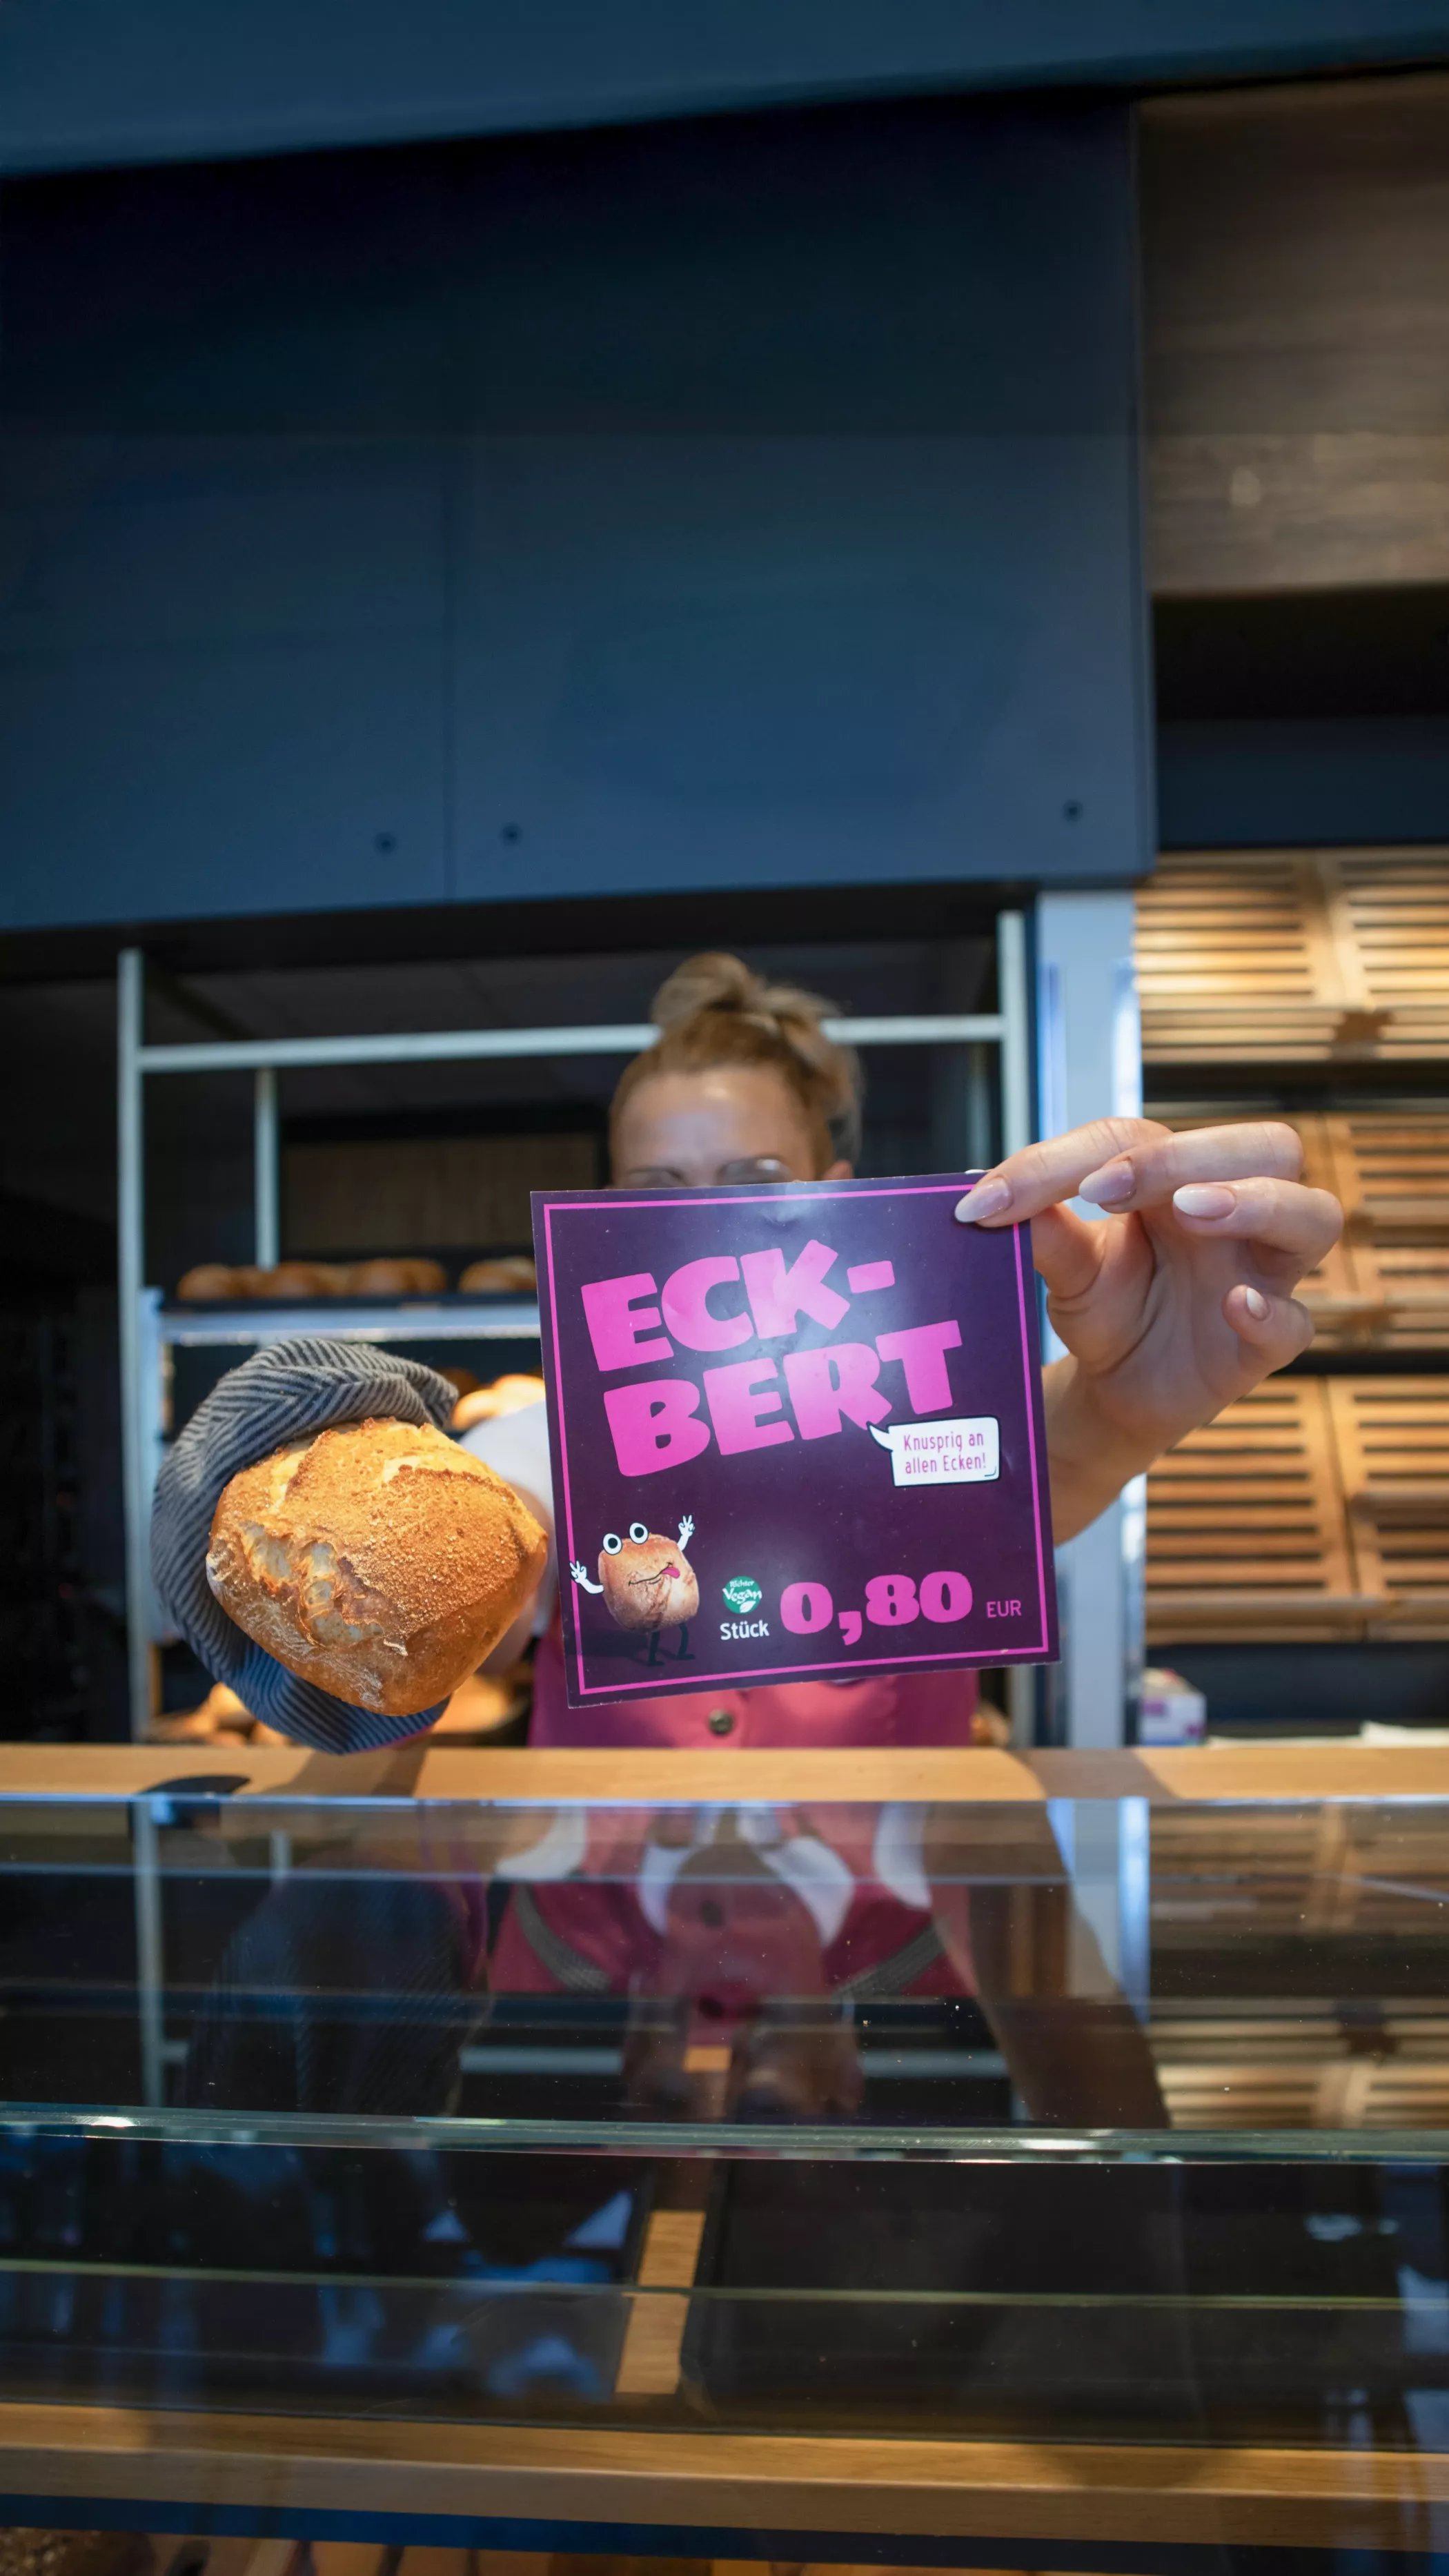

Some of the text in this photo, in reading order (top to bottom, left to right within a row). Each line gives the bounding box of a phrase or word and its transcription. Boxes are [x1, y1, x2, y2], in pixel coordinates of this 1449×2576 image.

[581, 1239, 896, 1371] ECK-
[603, 1319, 963, 1477] BERT
[904, 1431, 984, 1453] Knusprig an
[905, 1453, 986, 1474] allen Ecken!
[720, 1571, 1022, 1646] Stück 0,80 EUR
[722, 1586, 762, 1604] Vegan
